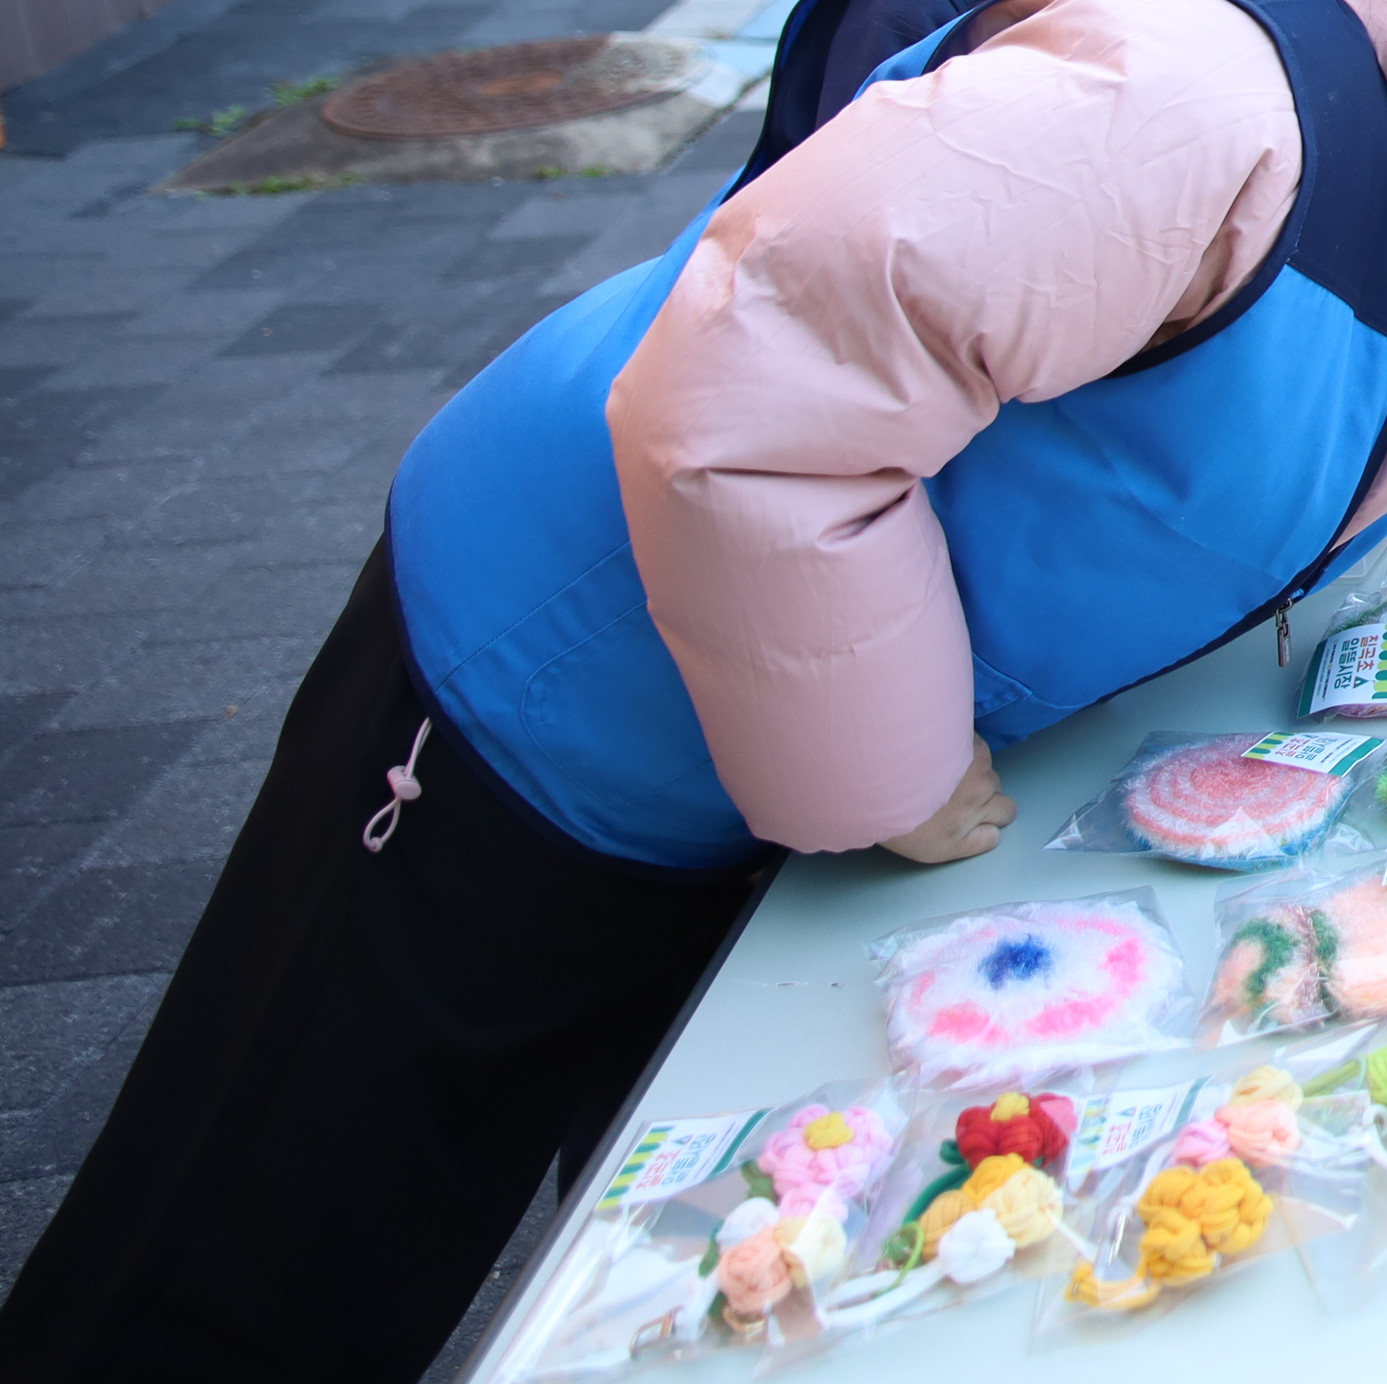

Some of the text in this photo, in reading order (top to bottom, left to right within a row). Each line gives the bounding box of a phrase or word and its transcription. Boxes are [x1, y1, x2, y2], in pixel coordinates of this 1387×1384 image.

[1333, 637, 1360, 690] 알뜰시장
[1356, 635, 1379, 671] 칠곡초
[1103, 1123, 1131, 1155] 칠곡초
[1129, 1103, 1163, 1148] 알뜰시장
[635, 1150, 681, 1189] 칠곡초
[660, 1133, 717, 1186] 알뜰시장
